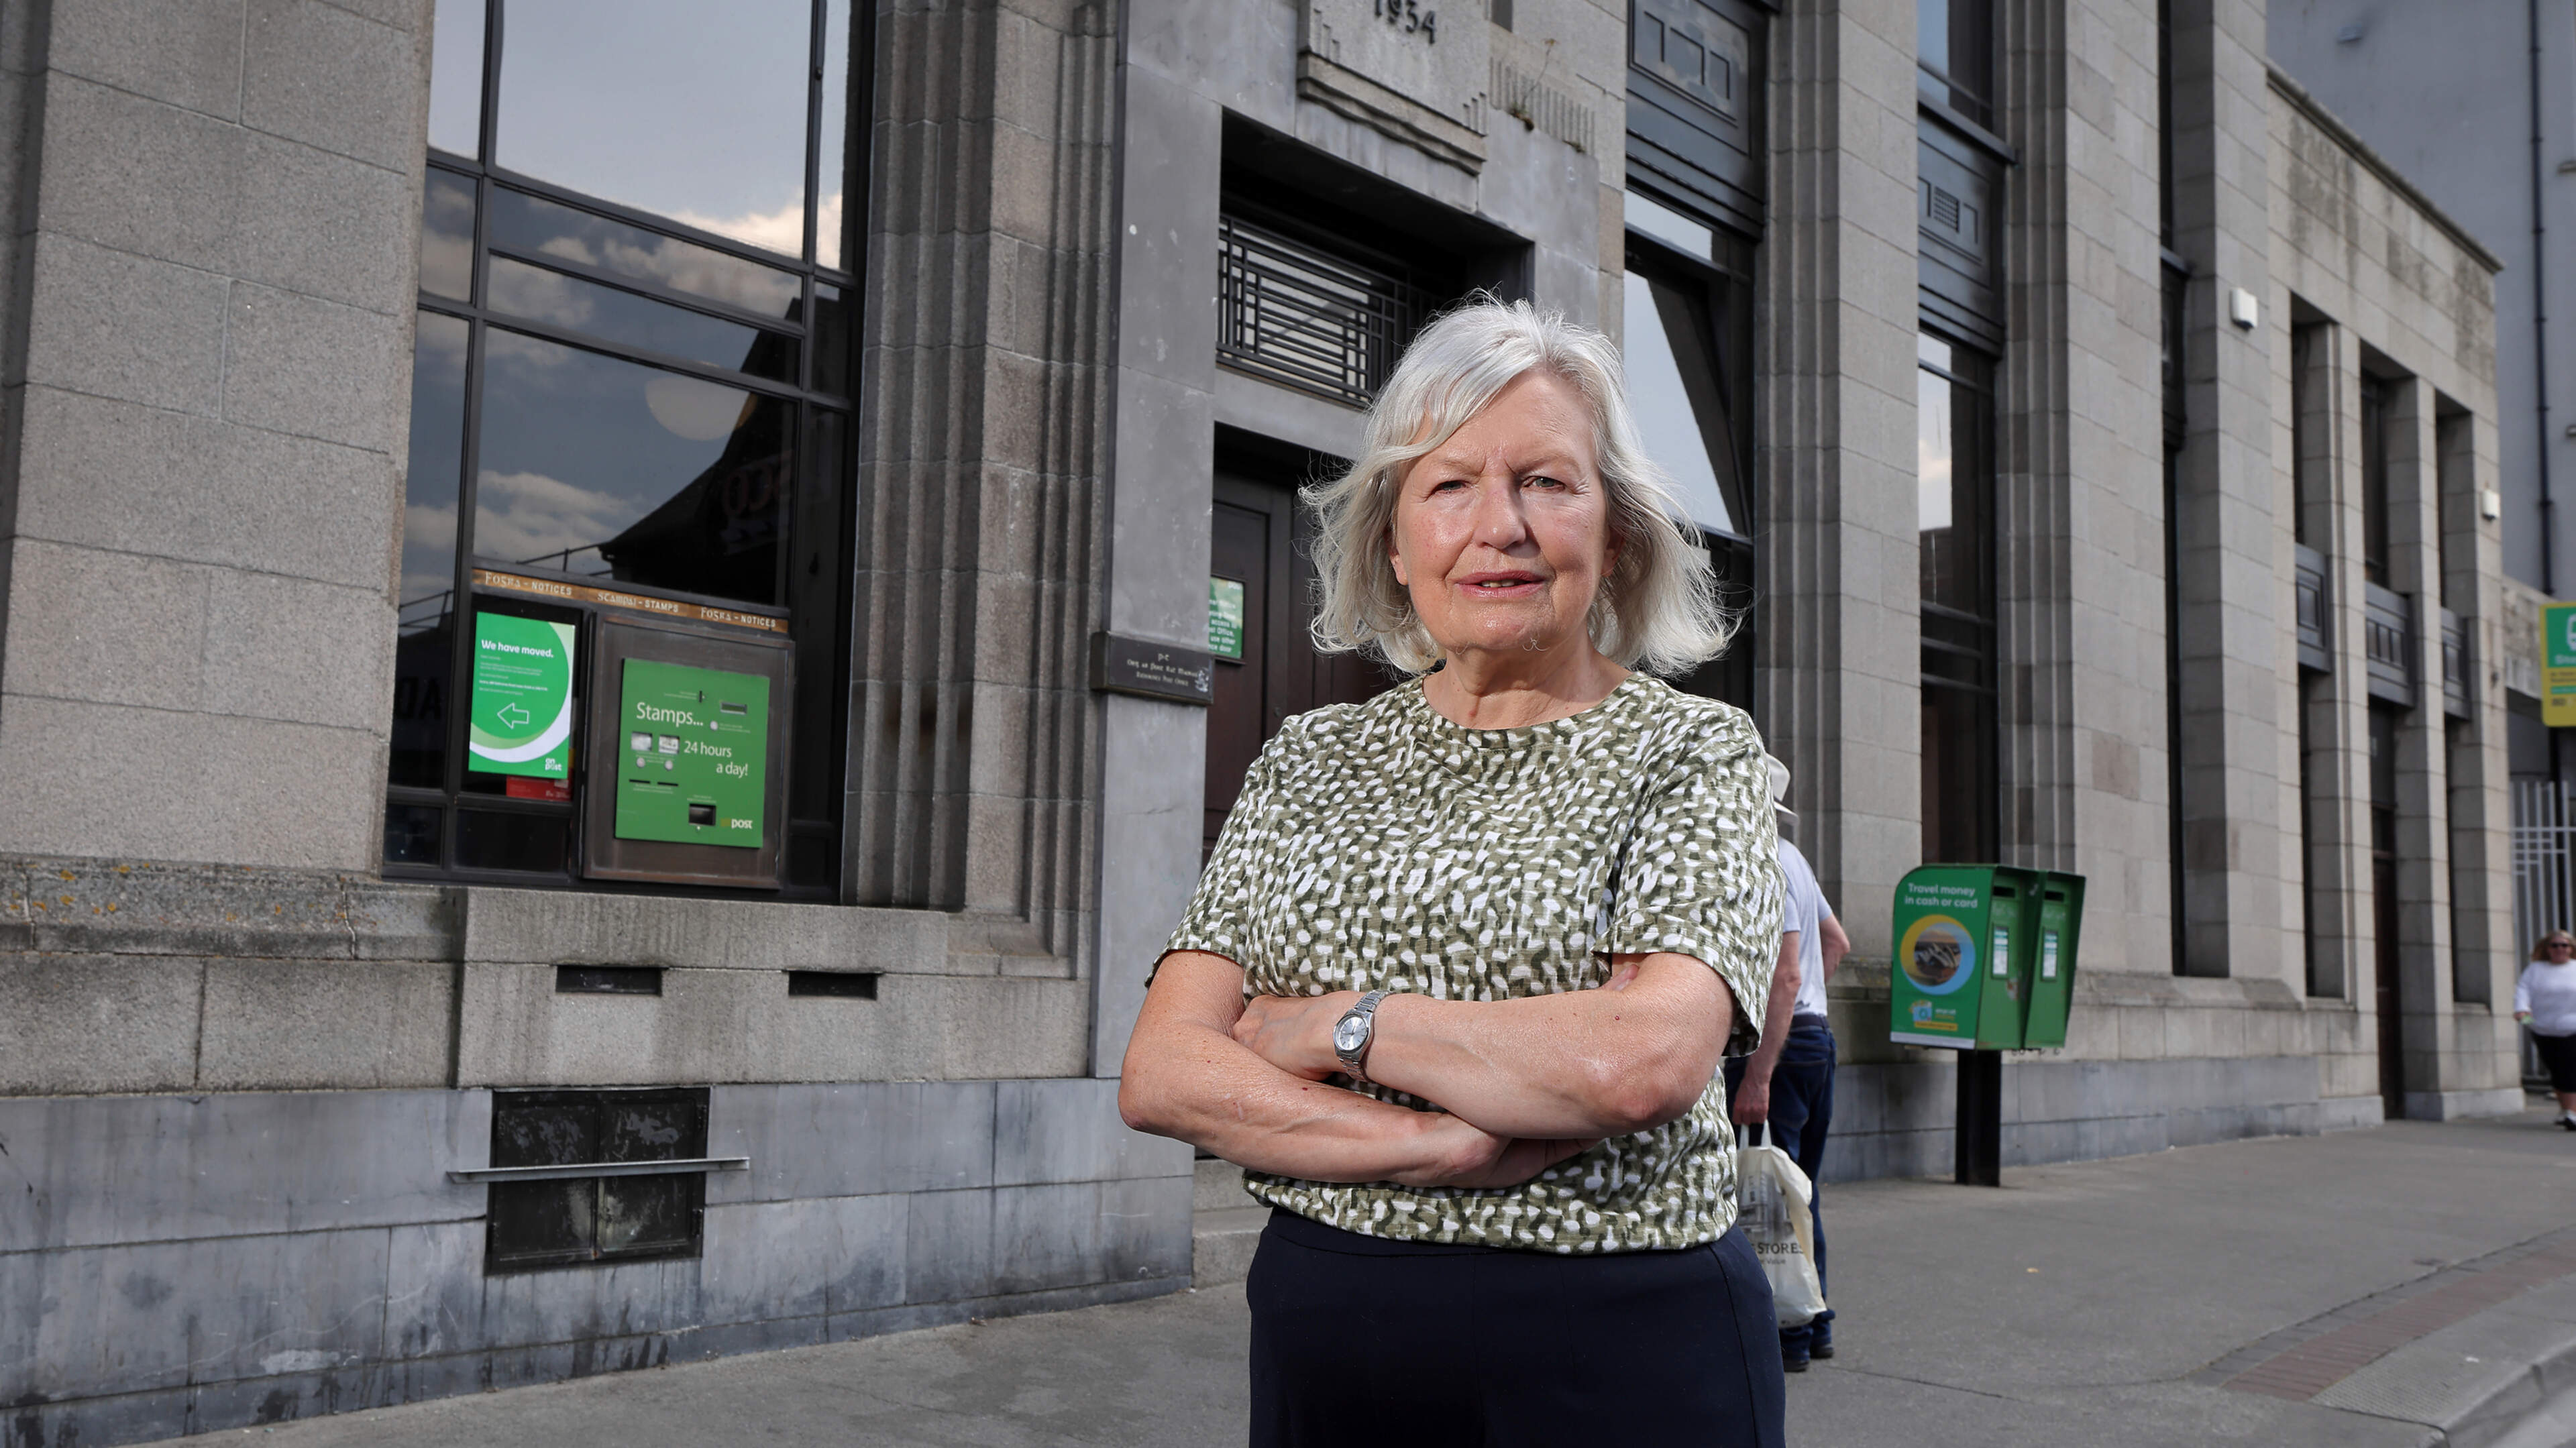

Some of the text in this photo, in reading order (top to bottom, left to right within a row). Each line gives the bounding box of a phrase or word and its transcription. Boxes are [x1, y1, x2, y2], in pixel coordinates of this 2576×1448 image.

[531, 581, 572, 596] NOTICES
[645, 600, 678, 613] STAMPS
[741, 613, 775, 628] NOTICES
[481, 638, 554, 658] We have moved.
[637, 702, 704, 728] Stamps...
[684, 740, 732, 758] 24 hours
[716, 761, 749, 779] a day!
[1908, 883, 1976, 898] Travel money
[1904, 895, 1978, 908] in cash or card
